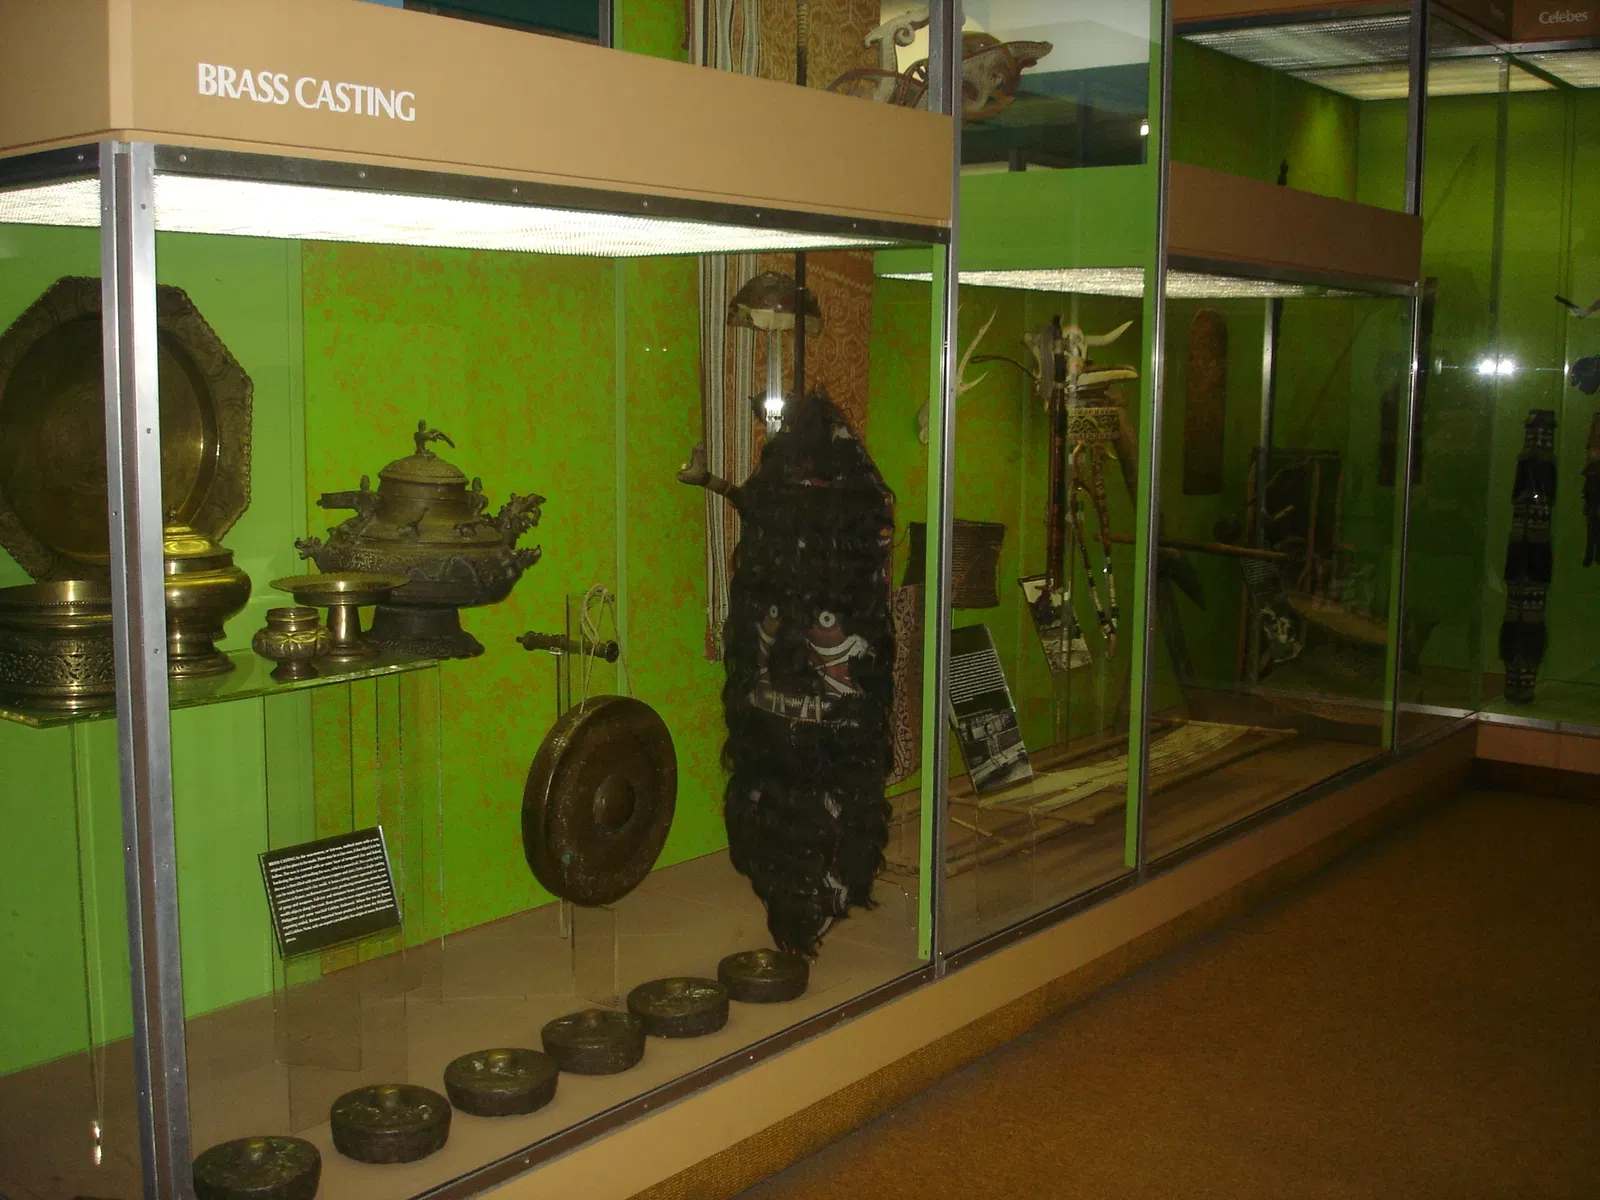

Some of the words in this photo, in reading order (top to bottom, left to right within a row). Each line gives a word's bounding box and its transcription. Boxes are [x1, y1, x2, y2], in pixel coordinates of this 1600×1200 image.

[1538, 9, 1588, 24] Celebes
[198, 62, 289, 105] BRASS
[295, 76, 416, 122] CASTING
